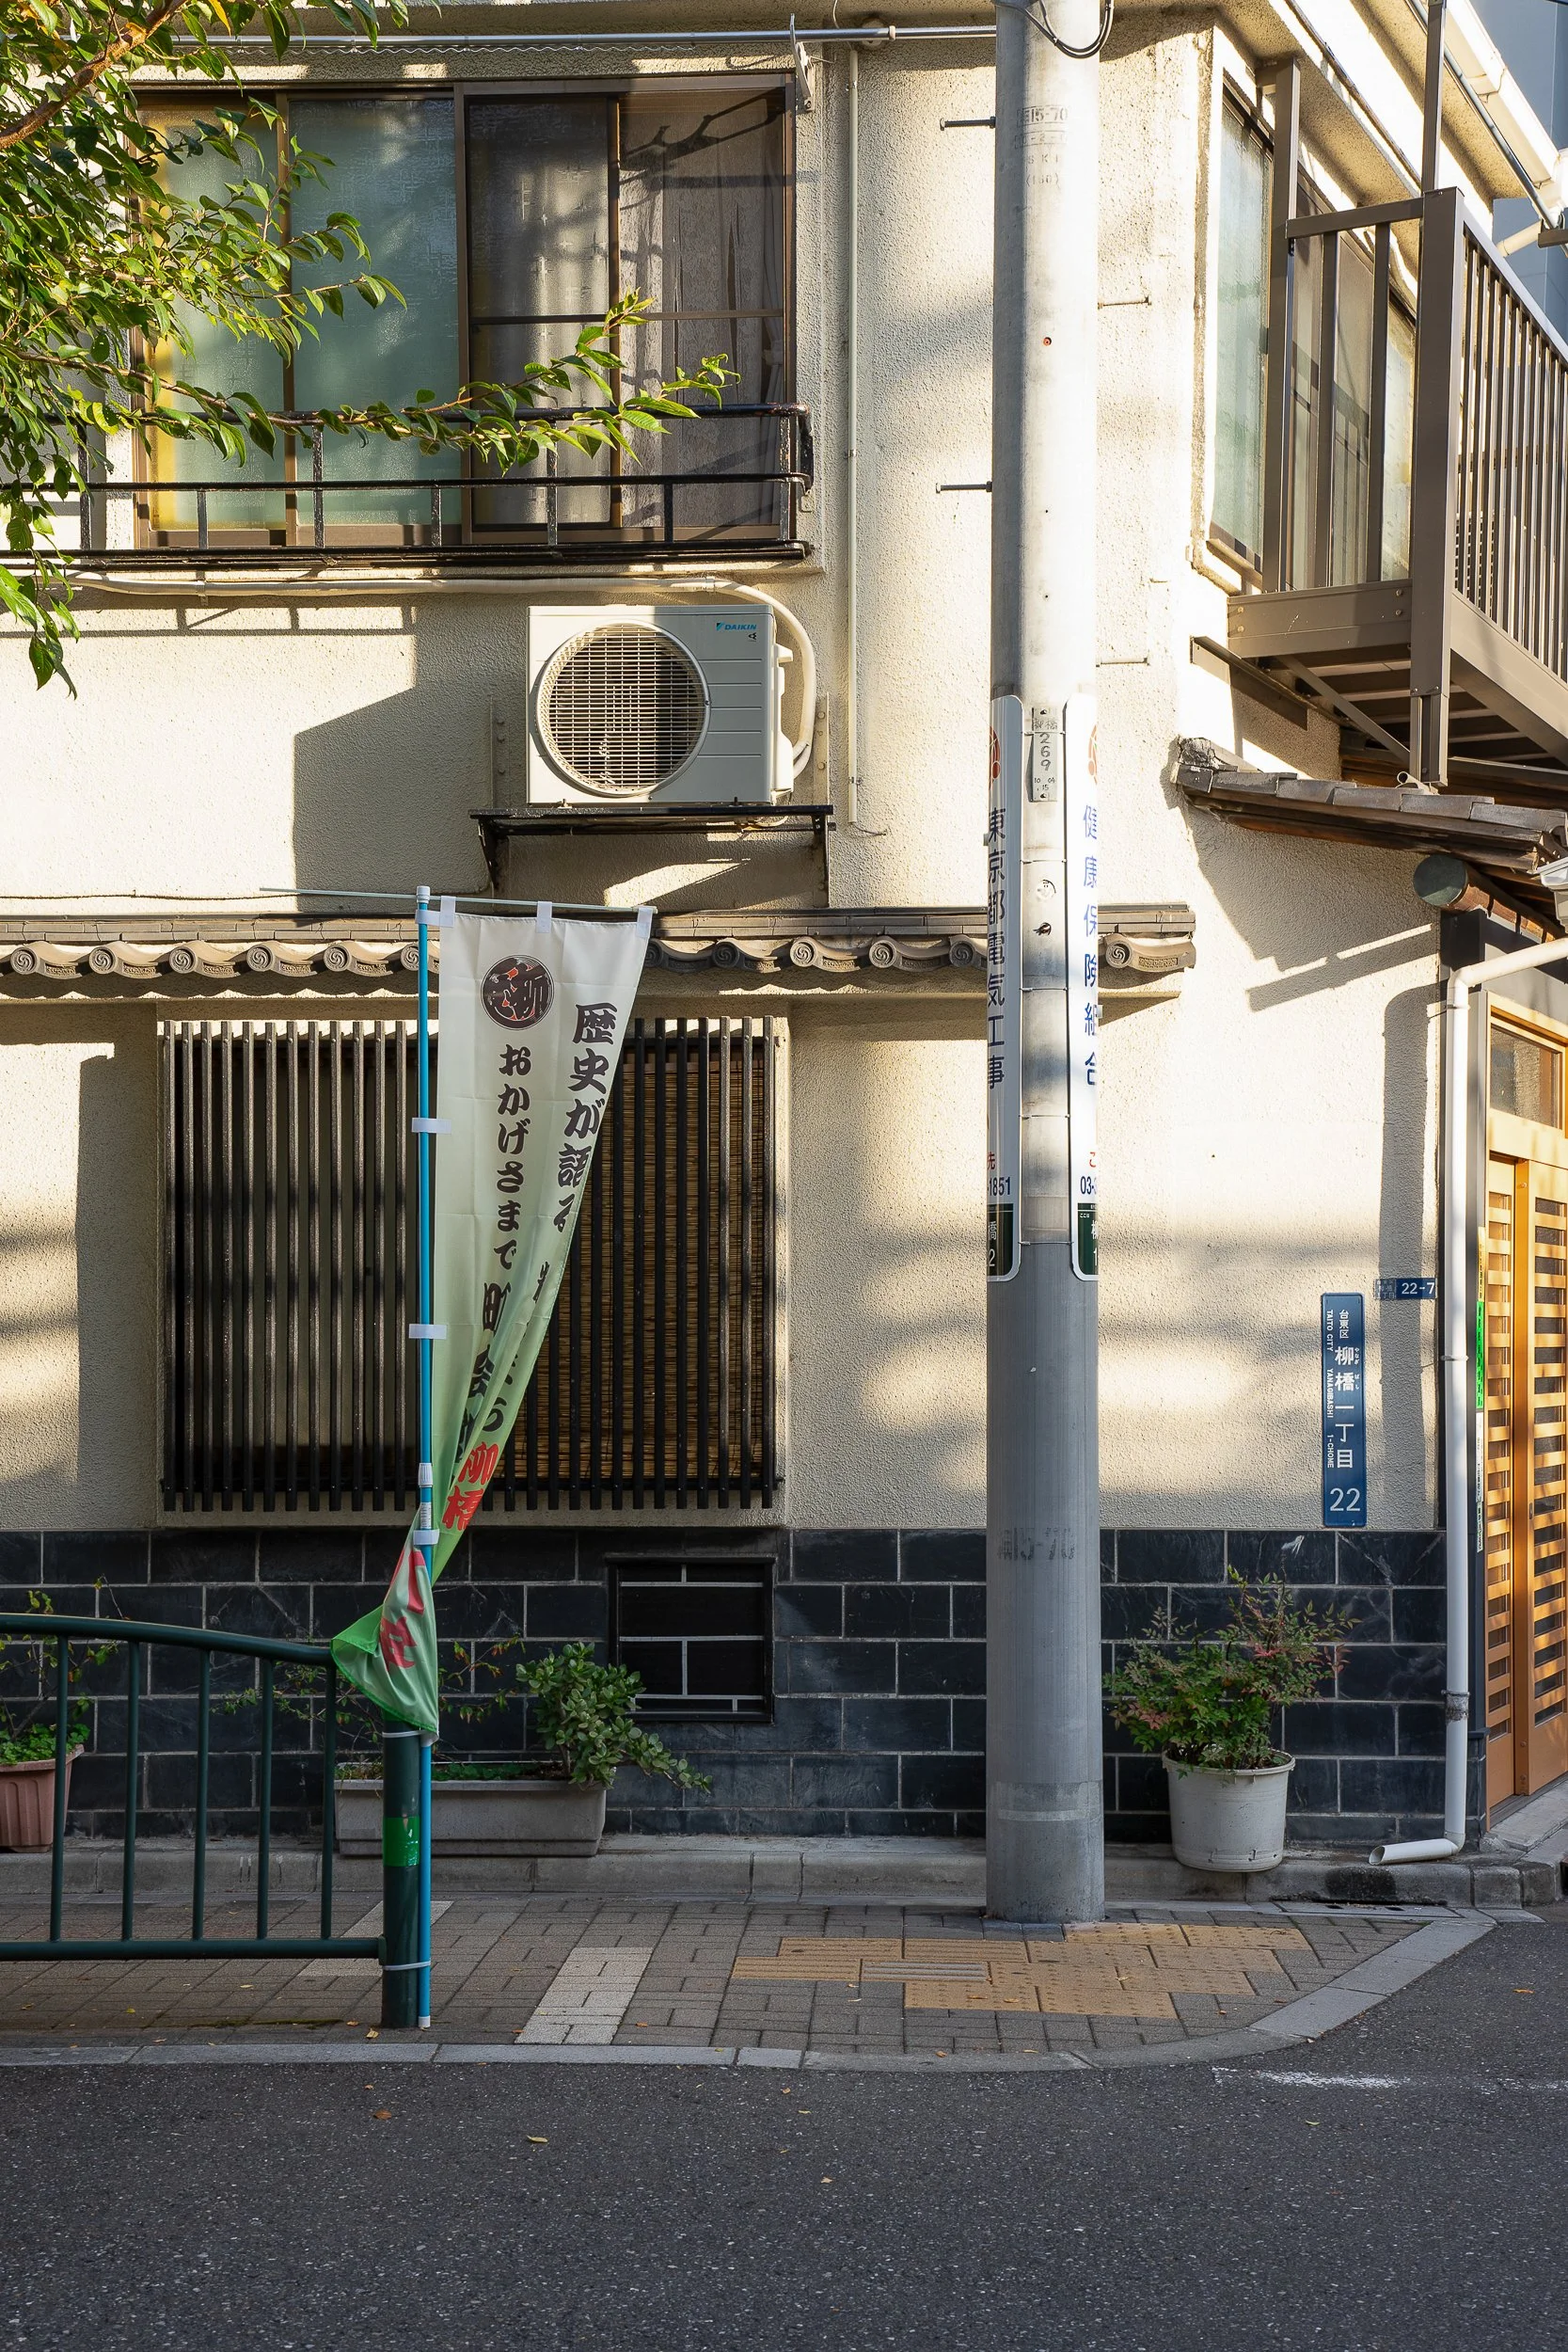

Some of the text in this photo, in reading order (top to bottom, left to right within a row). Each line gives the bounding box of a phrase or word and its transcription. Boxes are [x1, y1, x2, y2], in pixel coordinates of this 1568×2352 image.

[1039, 733, 1052, 771] 269
[1401, 1281, 1435, 1295] 22-7
[1334, 1309, 1355, 1469] 台東区 柳橋一丁目
[1329, 1487, 1361, 1512] 22
